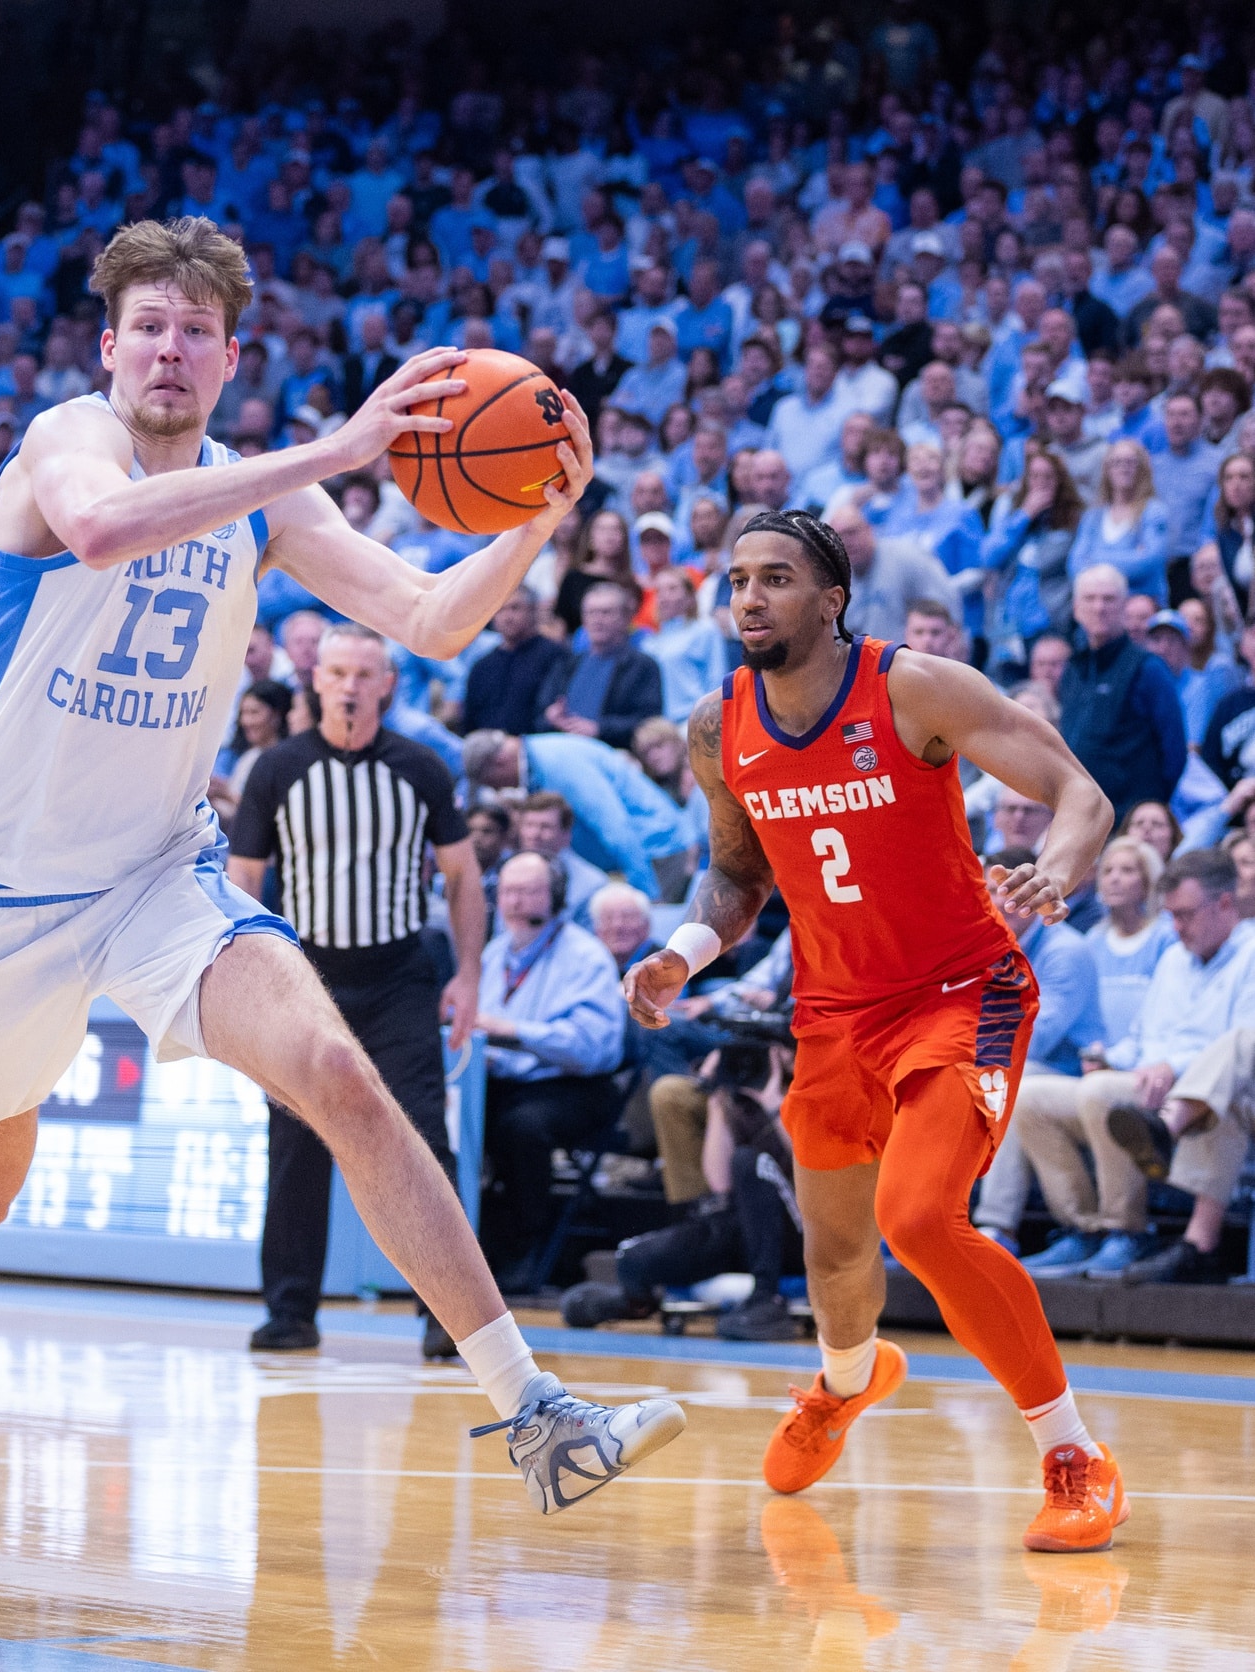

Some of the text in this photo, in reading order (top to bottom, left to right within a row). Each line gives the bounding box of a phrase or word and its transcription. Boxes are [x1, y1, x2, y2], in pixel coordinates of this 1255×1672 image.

[125, 539, 231, 590] NOTH
[97, 584, 210, 680] 13
[46, 667, 208, 729] CAROLINA
[743, 774, 896, 820] CLEMSON
[811, 827, 863, 904] 2
